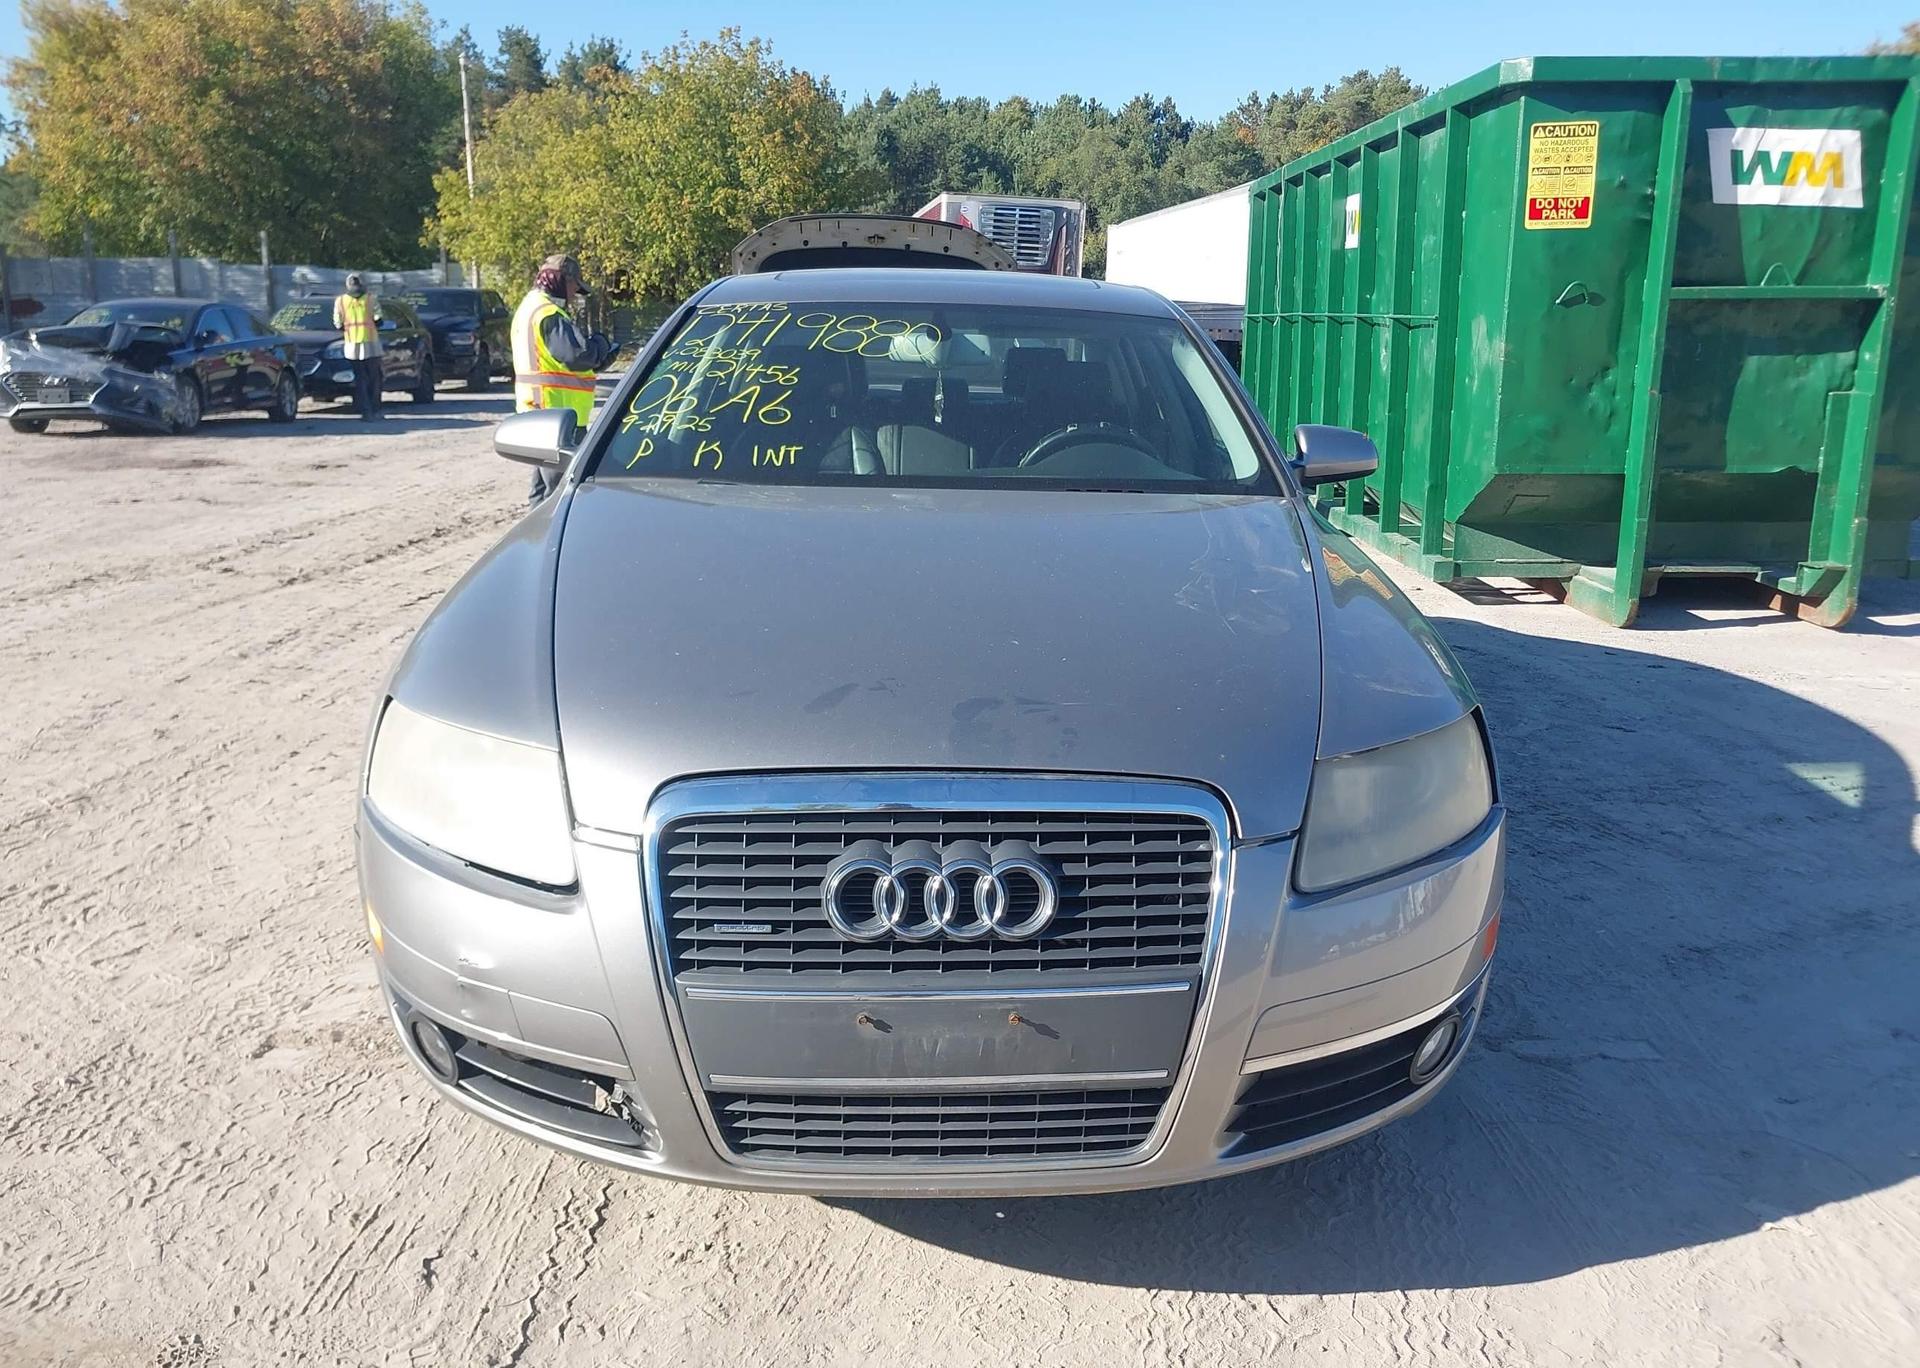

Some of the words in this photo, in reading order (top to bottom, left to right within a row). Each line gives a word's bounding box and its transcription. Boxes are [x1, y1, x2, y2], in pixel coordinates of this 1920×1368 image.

[1545, 125, 1595, 137] CAUTION
[1550, 138, 1589, 146] HAZARDOUS
[1730, 149, 1845, 188] WM
[1535, 199, 1555, 209] DO
[1558, 198, 1585, 209] NOT
[1541, 209, 1577, 220] PARK
[710, 385, 793, 425] A6
[626, 438, 654, 470] P
[693, 440, 723, 470] K
[753, 445, 804, 466] INT
